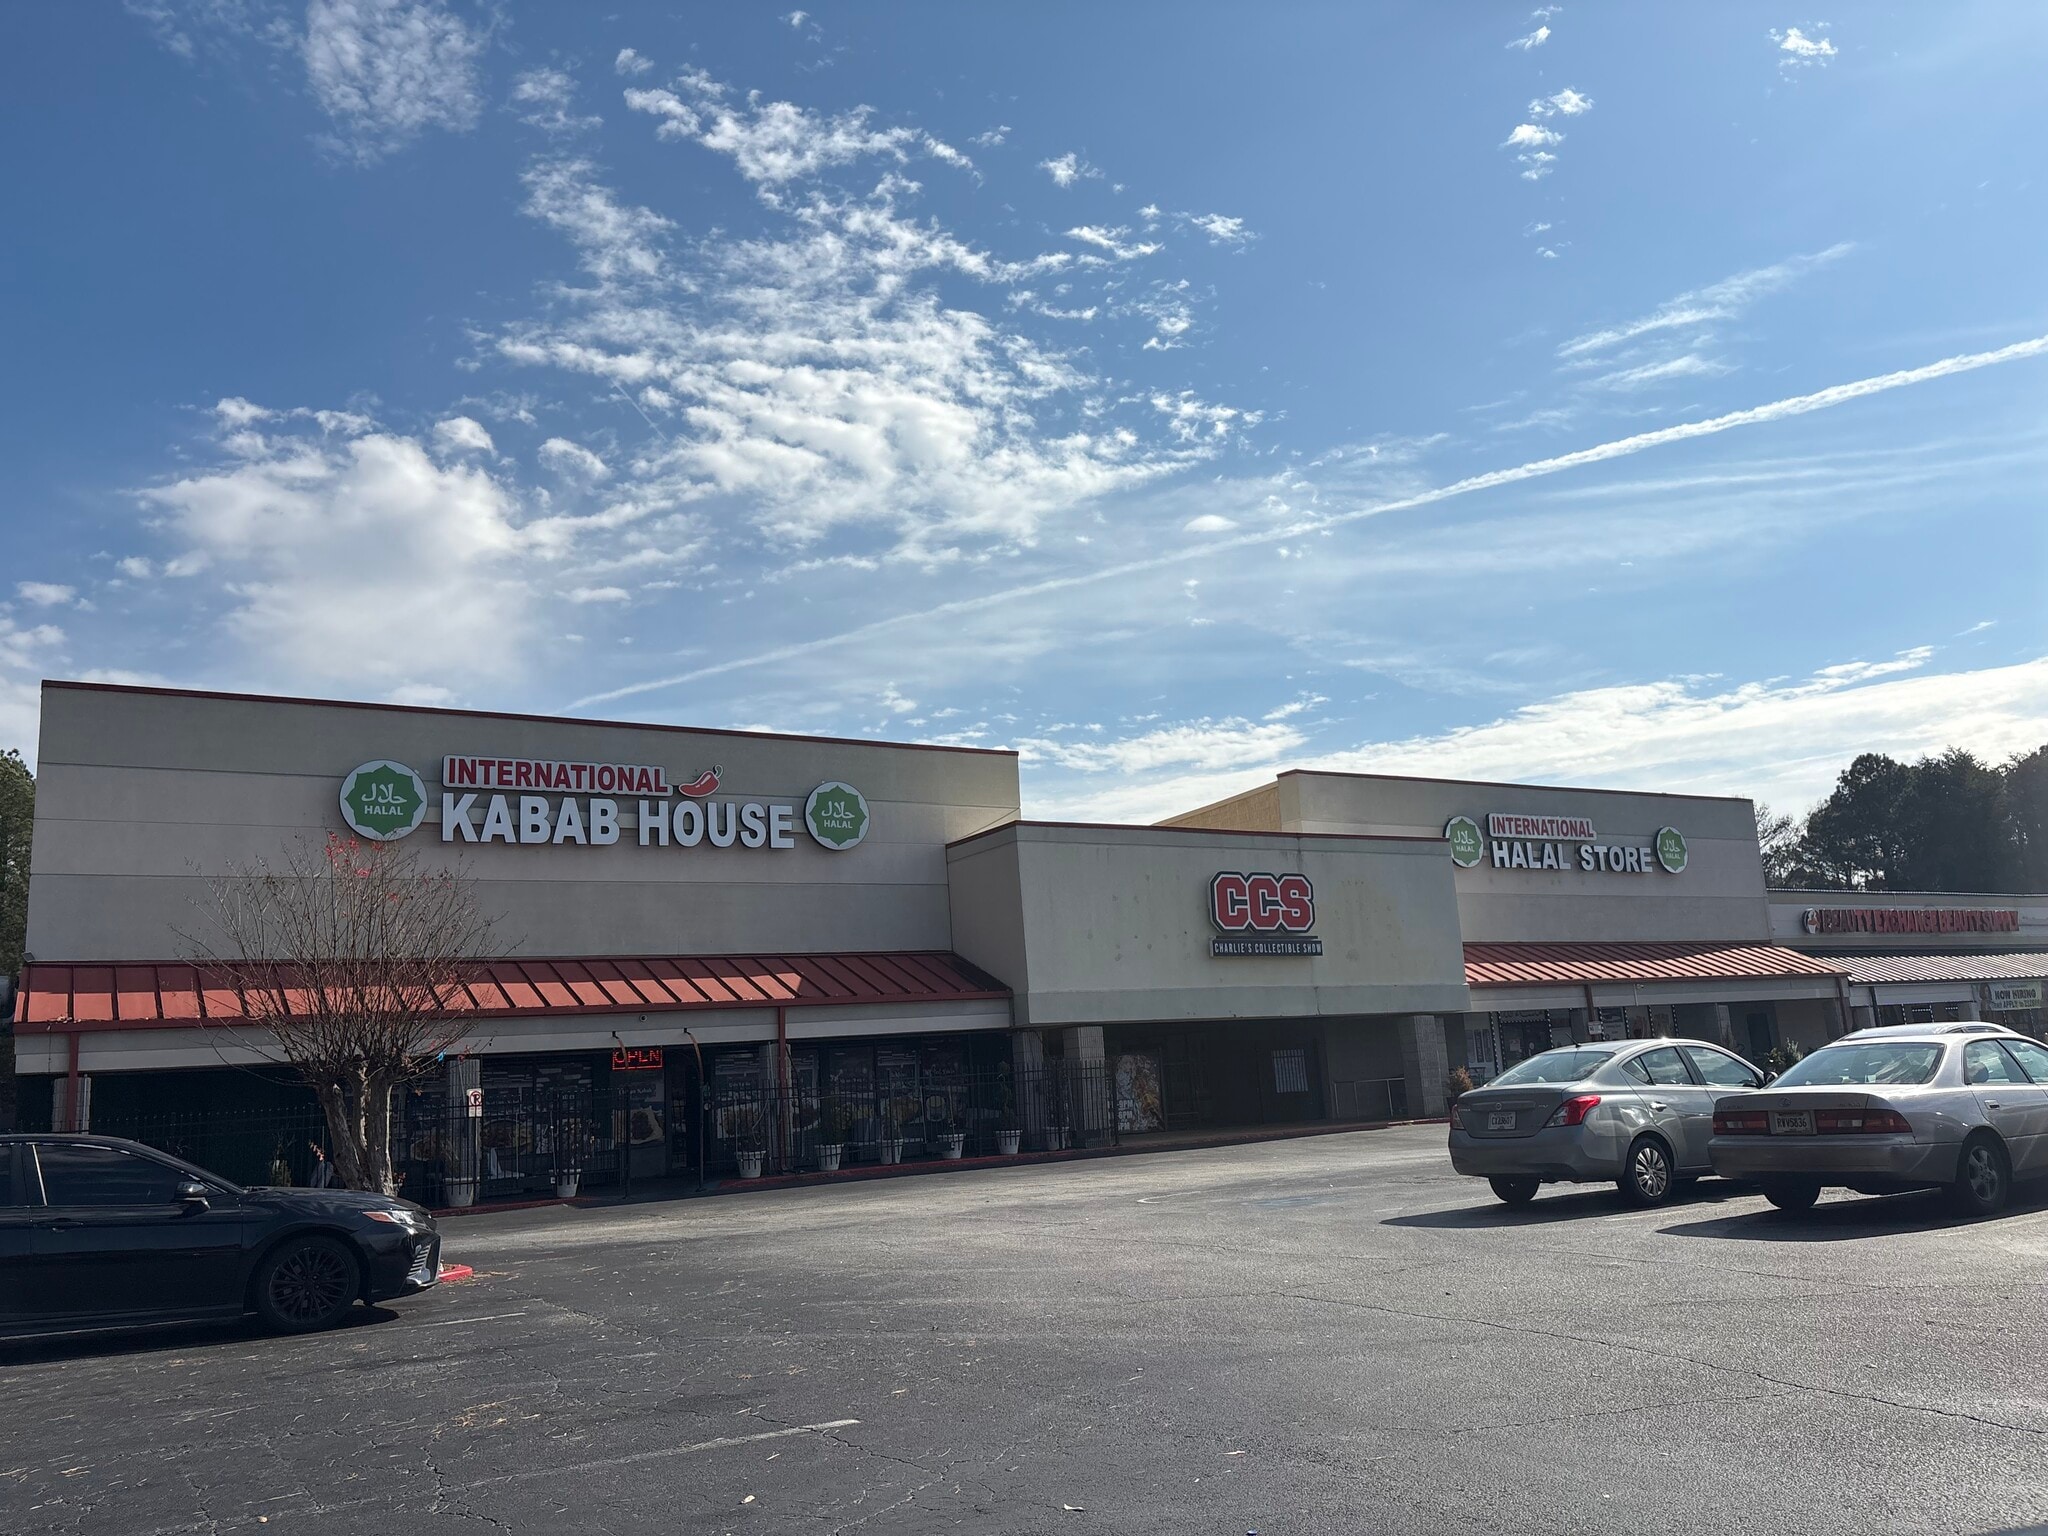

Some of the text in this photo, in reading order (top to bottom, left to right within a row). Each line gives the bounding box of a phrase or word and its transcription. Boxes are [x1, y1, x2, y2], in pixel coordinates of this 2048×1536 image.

[449, 757, 668, 793] INTERNATIONAL
[364, 805, 404, 816] HALAL
[442, 792, 795, 849] KABAB HOUSE
[823, 819, 853, 829] HALAL
[1491, 816, 1594, 838] INTERNATIONAL
[1456, 845, 1475, 853] HALAL
[1491, 840, 1653, 873] HALAL STORE
[1211, 872, 1315, 932] CCS
[1822, 909, 1873, 932] BEAUTY
[1874, 909, 1939, 932] EXCHANGE
[1939, 909, 1981, 932] BEAUTY
[1214, 942, 1252, 953] CHARLIE'S
[1254, 943, 1301, 954] COLLECTIBLE
